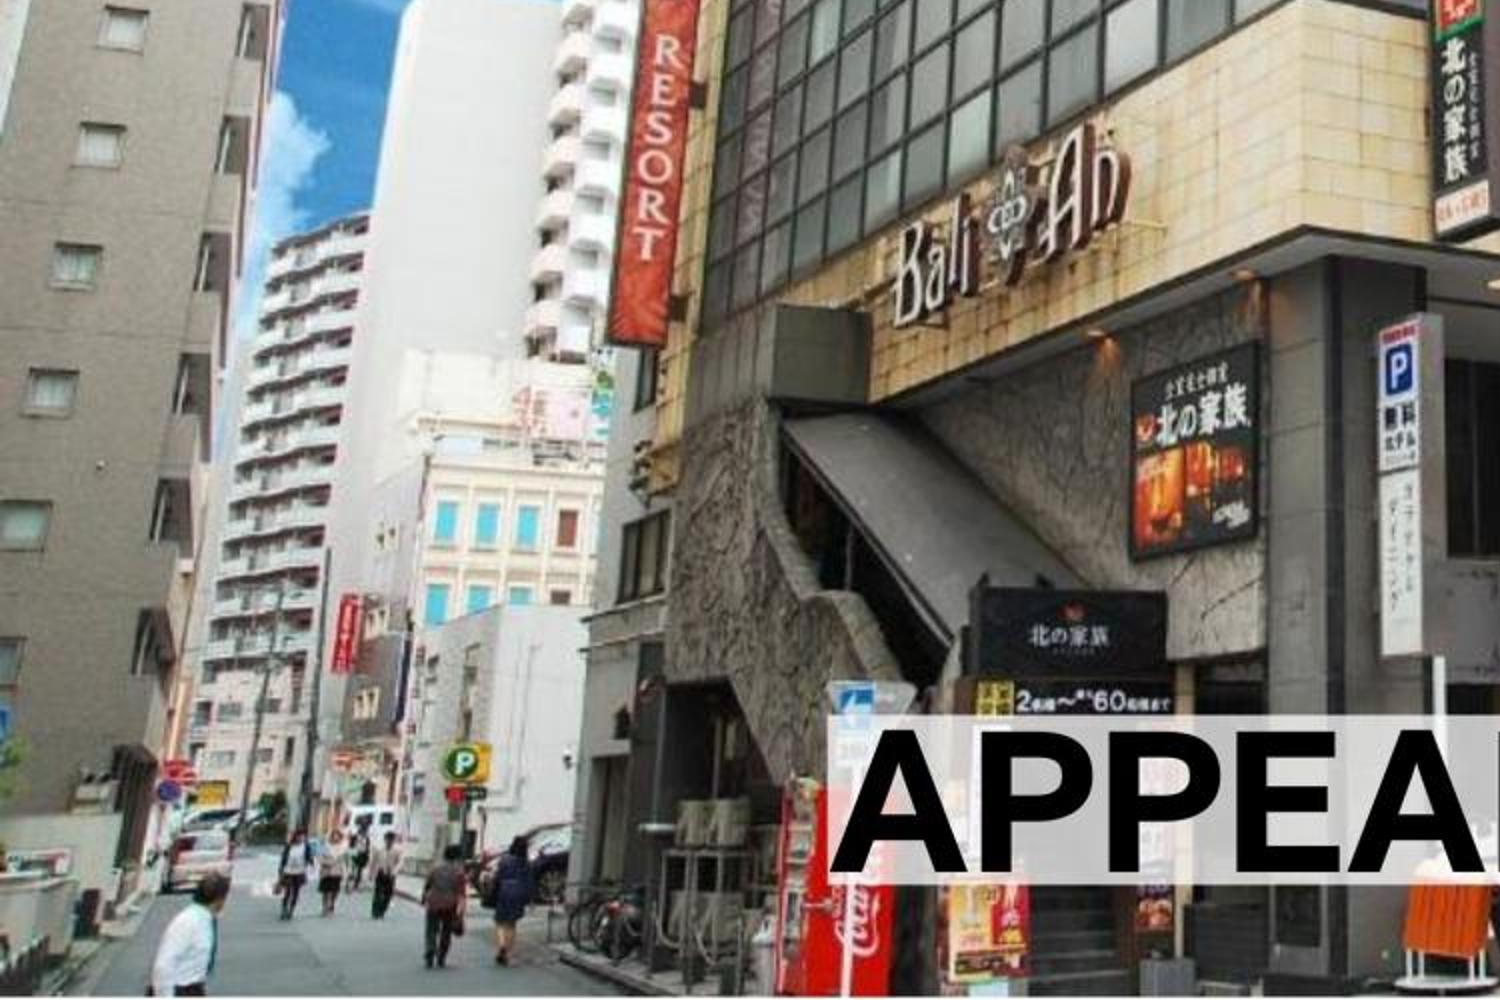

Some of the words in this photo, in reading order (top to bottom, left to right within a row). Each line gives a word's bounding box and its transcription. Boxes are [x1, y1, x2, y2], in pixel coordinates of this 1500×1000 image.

[1441, 36, 1468, 184] 北の家族
[633, 33, 682, 261] RESORT
[891, 193, 974, 329] Bali
[1024, 122, 1121, 268] An
[1390, 350, 1408, 390] P
[1156, 381, 1248, 447] 北の家族
[1029, 623, 1110, 647] 北の家族
[453, 750, 475, 776] P
